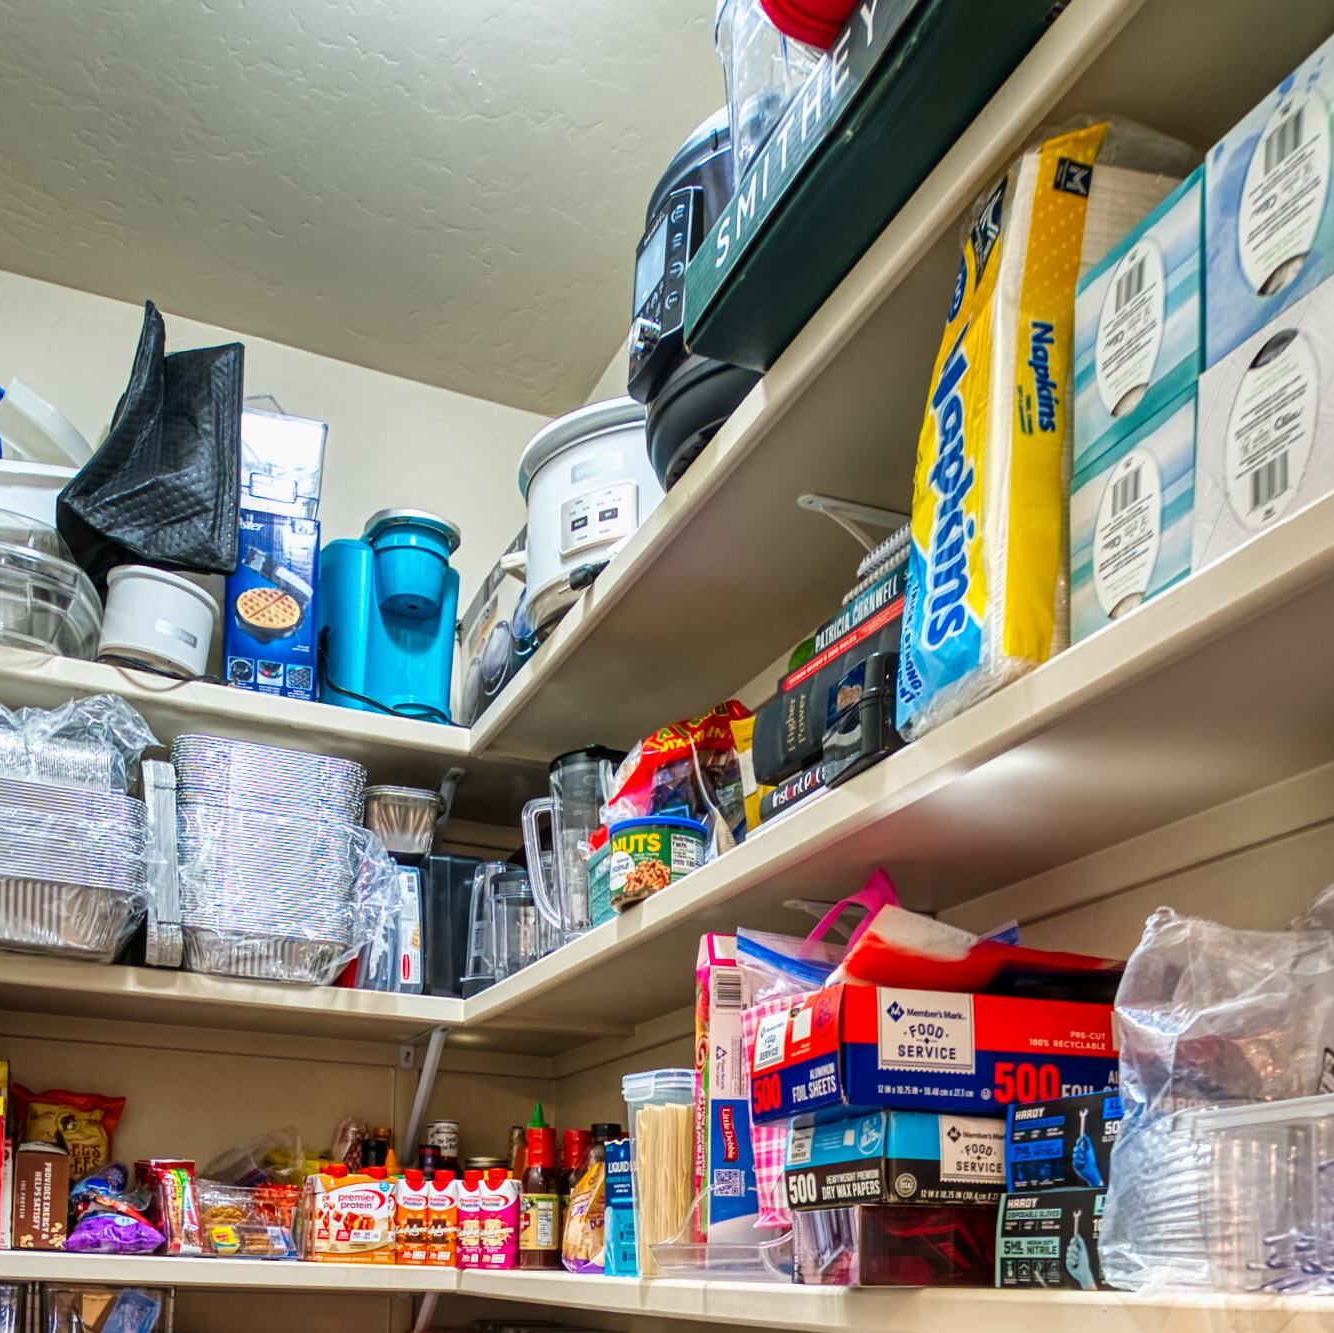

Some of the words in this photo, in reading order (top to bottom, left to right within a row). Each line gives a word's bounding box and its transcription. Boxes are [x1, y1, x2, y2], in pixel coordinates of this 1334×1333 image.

[715, 5, 876, 268] SMITHEY
[1028, 320, 1059, 434] Napkins
[815, 612, 851, 653] PATRICIA
[852, 575, 898, 625] CORNWELL
[788, 698, 796, 752] Higher
[799, 693, 807, 744] Power
[612, 833, 661, 854] NUTS
[907, 1008, 943, 1019] Member's
[909, 1023, 944, 1039] FOOD
[1070, 1031, 1107, 1041] PRE-CUT
[898, 1045, 957, 1060] SERVICE
[1029, 1038, 1050, 1047] 100%
[1053, 1039, 1107, 1050] RECYCLABLE
[753, 1073, 781, 1115] 500
[792, 1081, 808, 1104] FOIL
[809, 1076, 837, 1099] SHEETS
[993, 1061, 1061, 1105] 500
[721, 1106, 734, 1131] Little
[1014, 1107, 1045, 1121] HARDY
[696, 1088, 707, 1177] Strawberry
[724, 1132, 736, 1161] Debbie
[964, 1143, 994, 1157] FOOD
[608, 1161, 629, 1174] LIQUID
[956, 1160, 1003, 1173] SERVICE
[33, 1171, 42, 1199] HELPS
[42, 1162, 52, 1201] PROVIDES
[789, 1174, 817, 1204] 500
[821, 1187, 836, 1201] DRY
[836, 1184, 852, 1199] WAX
[853, 1180, 881, 1197] PAPERS
[338, 1194, 375, 1203] premier
[340, 1201, 372, 1210] protein
[1027, 1244, 1057, 1255] NITRILE
